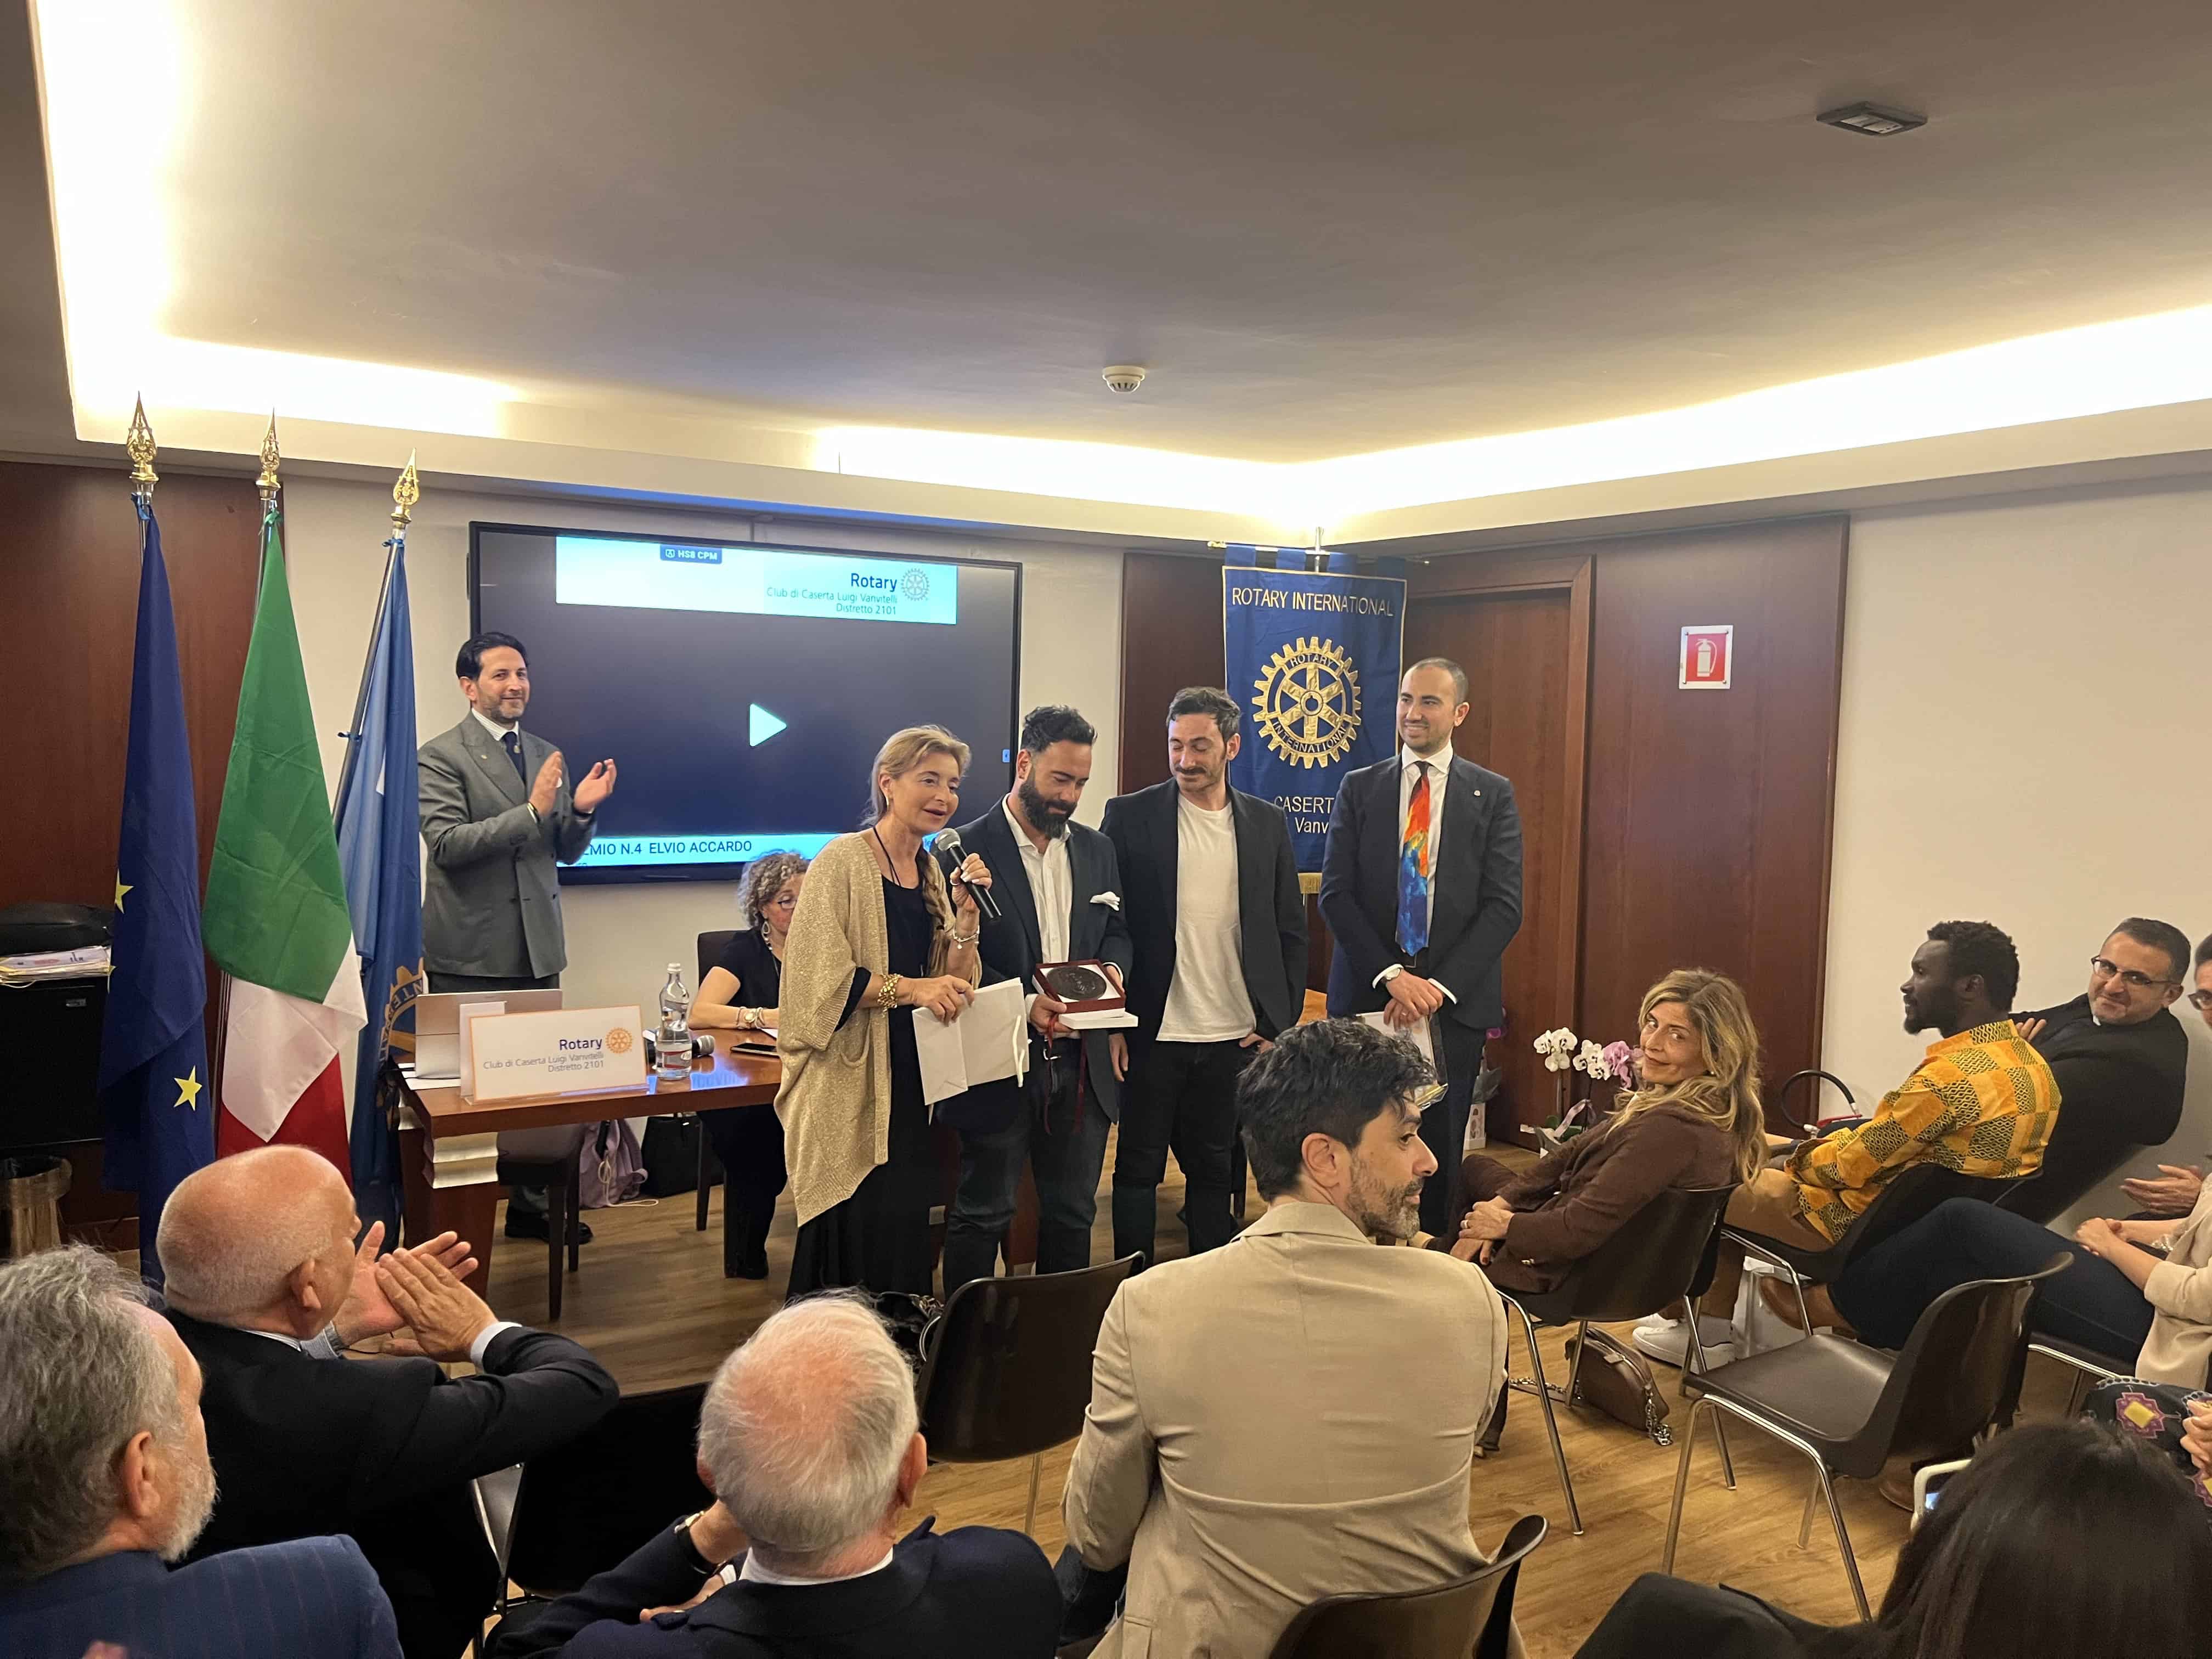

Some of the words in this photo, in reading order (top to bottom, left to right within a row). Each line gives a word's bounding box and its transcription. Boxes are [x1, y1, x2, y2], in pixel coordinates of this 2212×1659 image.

[697, 551, 718, 560] CPM
[851, 573, 897, 592] Rotary
[767, 587, 787, 597] Club
[791, 588, 799, 597] di
[802, 589, 834, 600] Caserta
[838, 592, 857, 603] Luigi
[860, 593, 898, 603] Vanvitelli
[1232, 588, 1288, 608] ROTARY
[1293, 592, 1393, 617] INTERNATIONAL
[837, 603, 873, 613] Distretto
[875, 605, 896, 614] 2101
[1290, 653, 1334, 667] ROTARY
[1273, 721, 1346, 753] INTERNATIONAL
[1274, 796, 1334, 814] CASERT
[1295, 817, 1329, 834] Vanv
[584, 843, 616, 855] MIO
[621, 843, 642, 854] N.4
[650, 842, 685, 854] ELVIO
[690, 841, 752, 853] ACCARDO
[559, 1039, 602, 1050] Rotary
[483, 1060, 503, 1069] Club
[505, 1059, 513, 1067] di
[516, 1058, 546, 1067] Caserta
[548, 1054, 567, 1065] Luigi
[548, 1063, 582, 1073] Distretto
[584, 1060, 604, 1069] 2101
